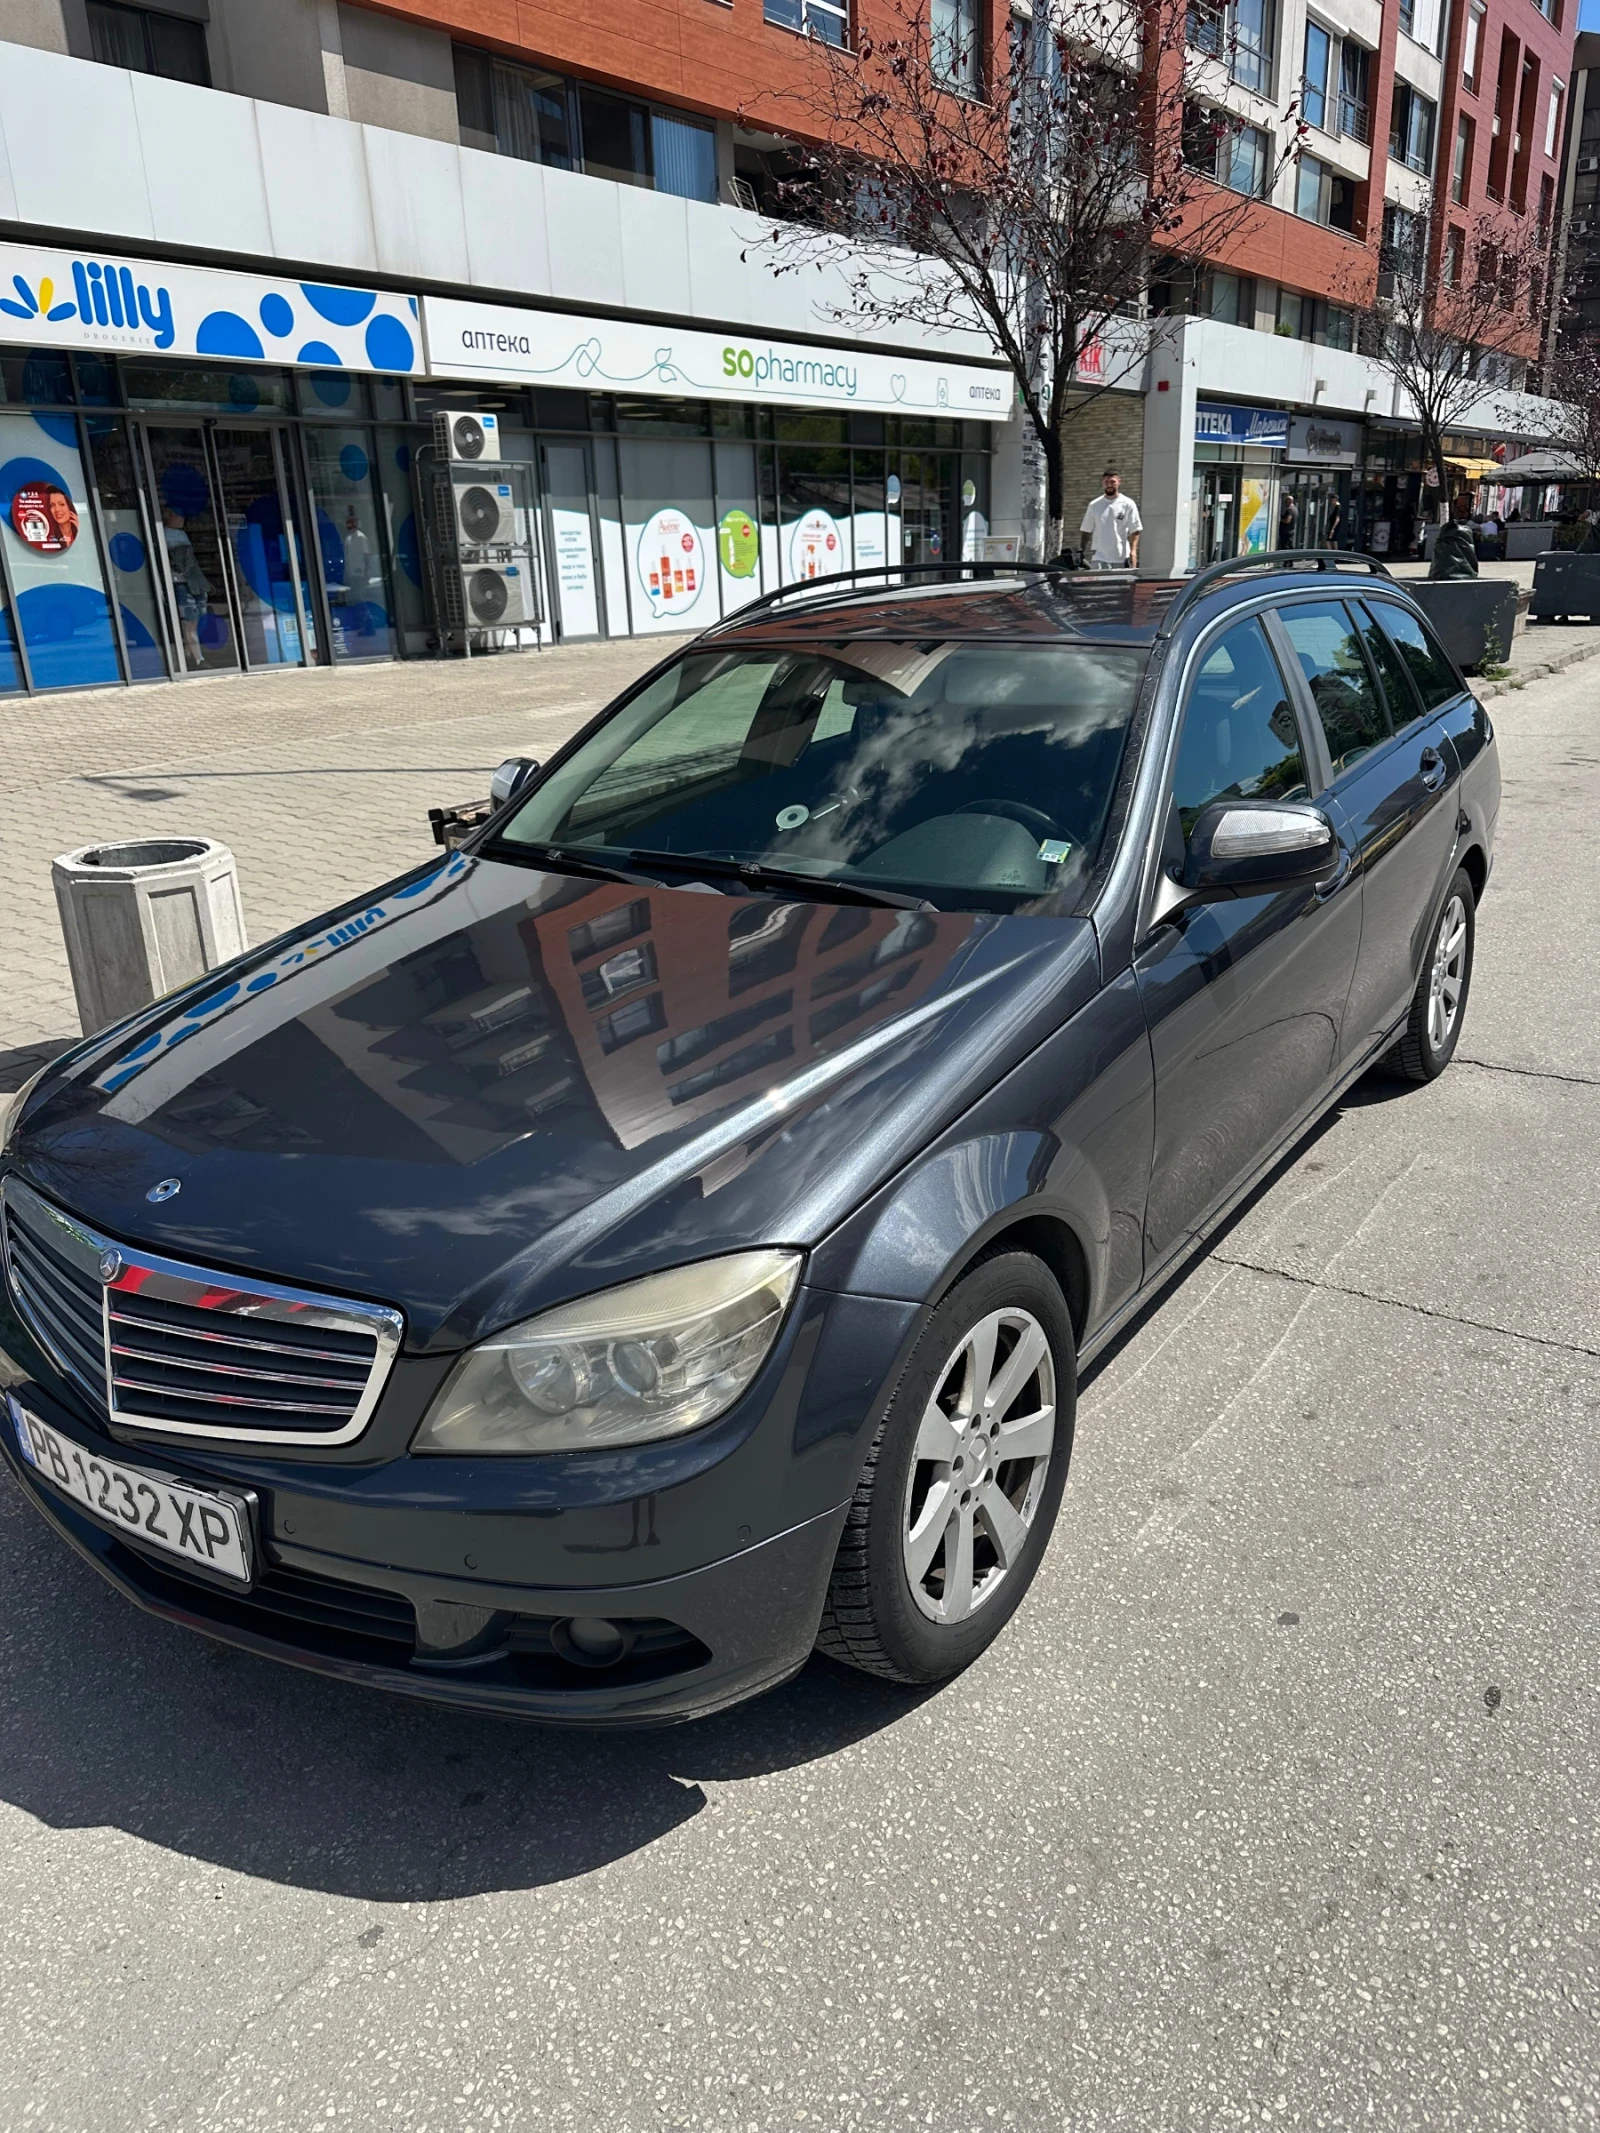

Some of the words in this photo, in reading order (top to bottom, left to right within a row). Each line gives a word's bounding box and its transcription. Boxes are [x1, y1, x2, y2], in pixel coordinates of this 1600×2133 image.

[72, 261, 175, 349] lilly
[83, 332, 152, 344] DROGERIE
[462, 329, 531, 354] аптека
[969, 384, 1001, 401] аптека
